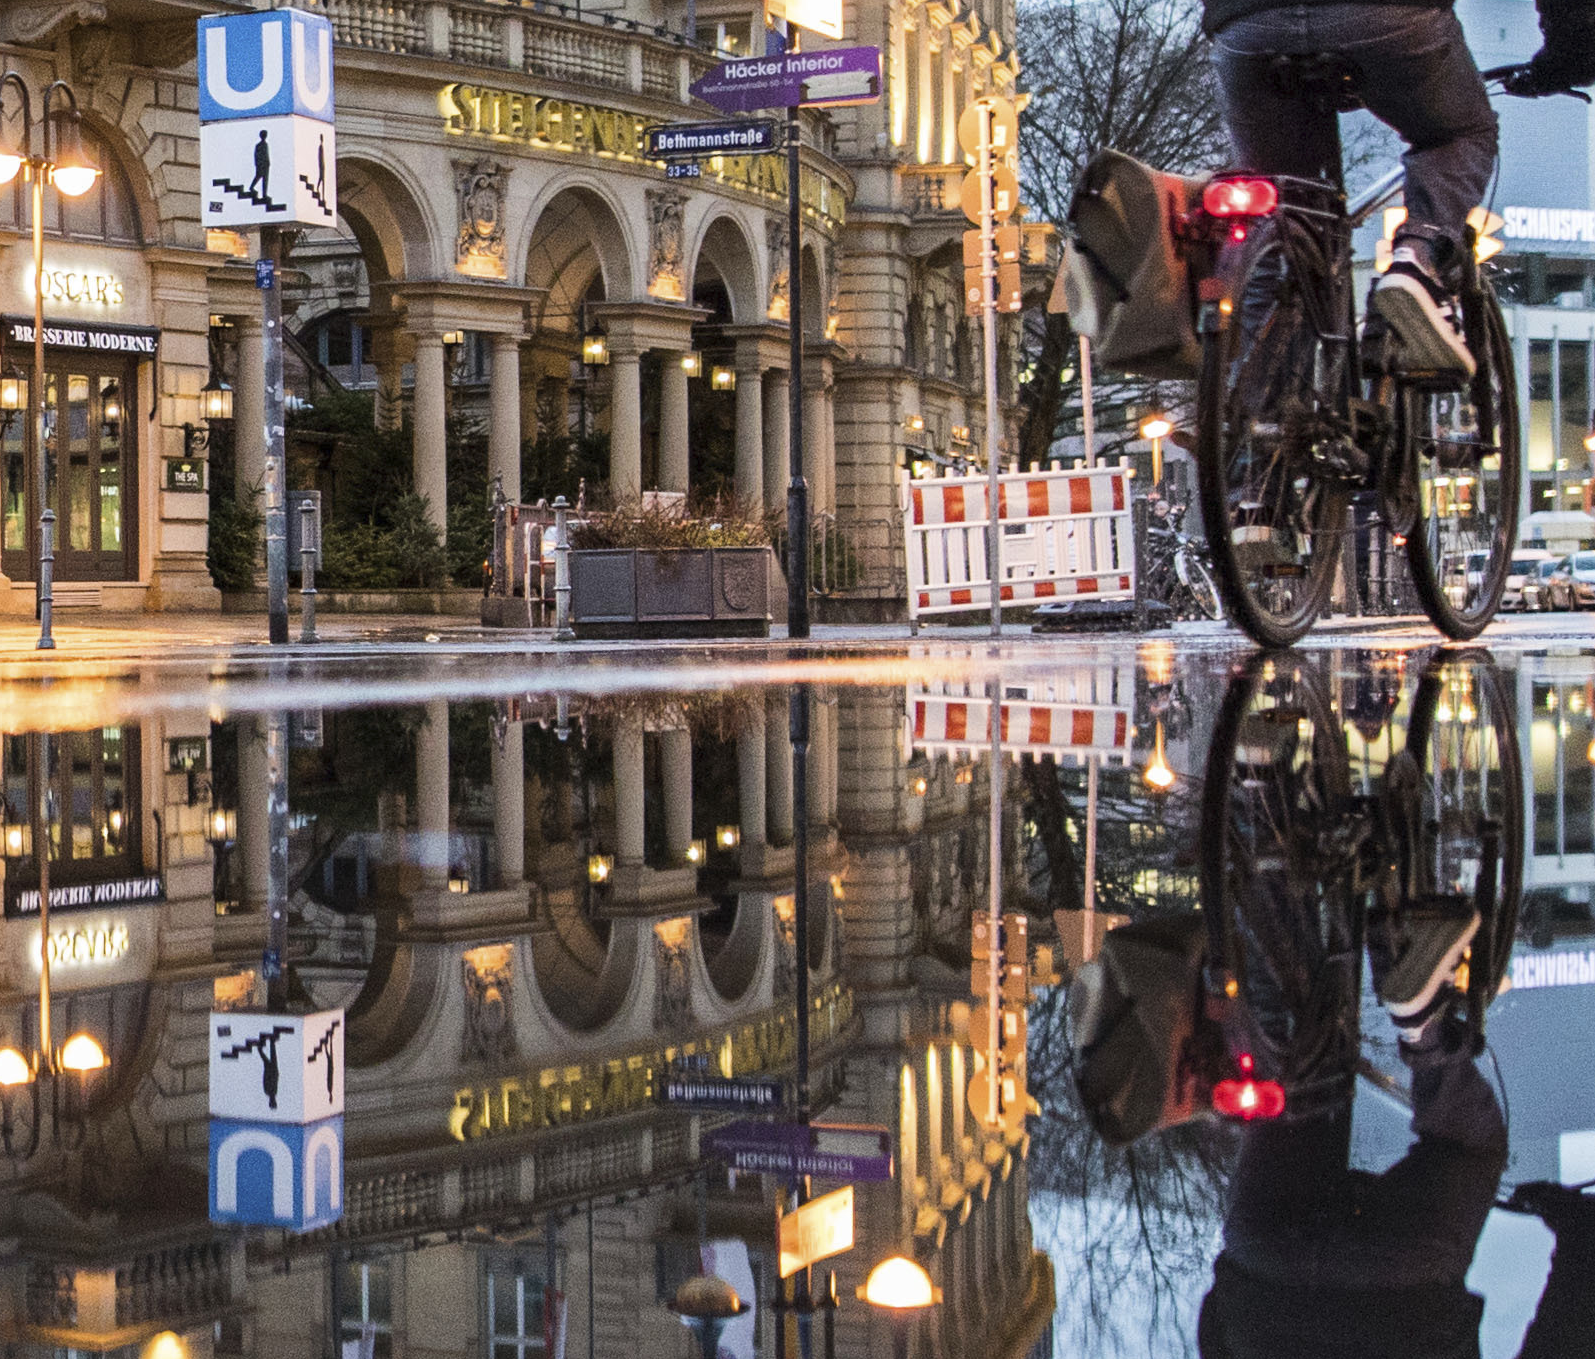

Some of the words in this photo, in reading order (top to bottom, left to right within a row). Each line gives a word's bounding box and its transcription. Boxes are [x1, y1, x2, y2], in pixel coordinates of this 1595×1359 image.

[206, 21, 284, 111] U
[294, 21, 330, 112] U
[724, 61, 783, 80] Häcker
[786, 55, 844, 74] Interior
[658, 129, 764, 150] Bethmannstraße
[667, 165, 700, 179] 33-35
[14, 324, 87, 348] BRSSERIE
[89, 332, 156, 353] MODERNE
